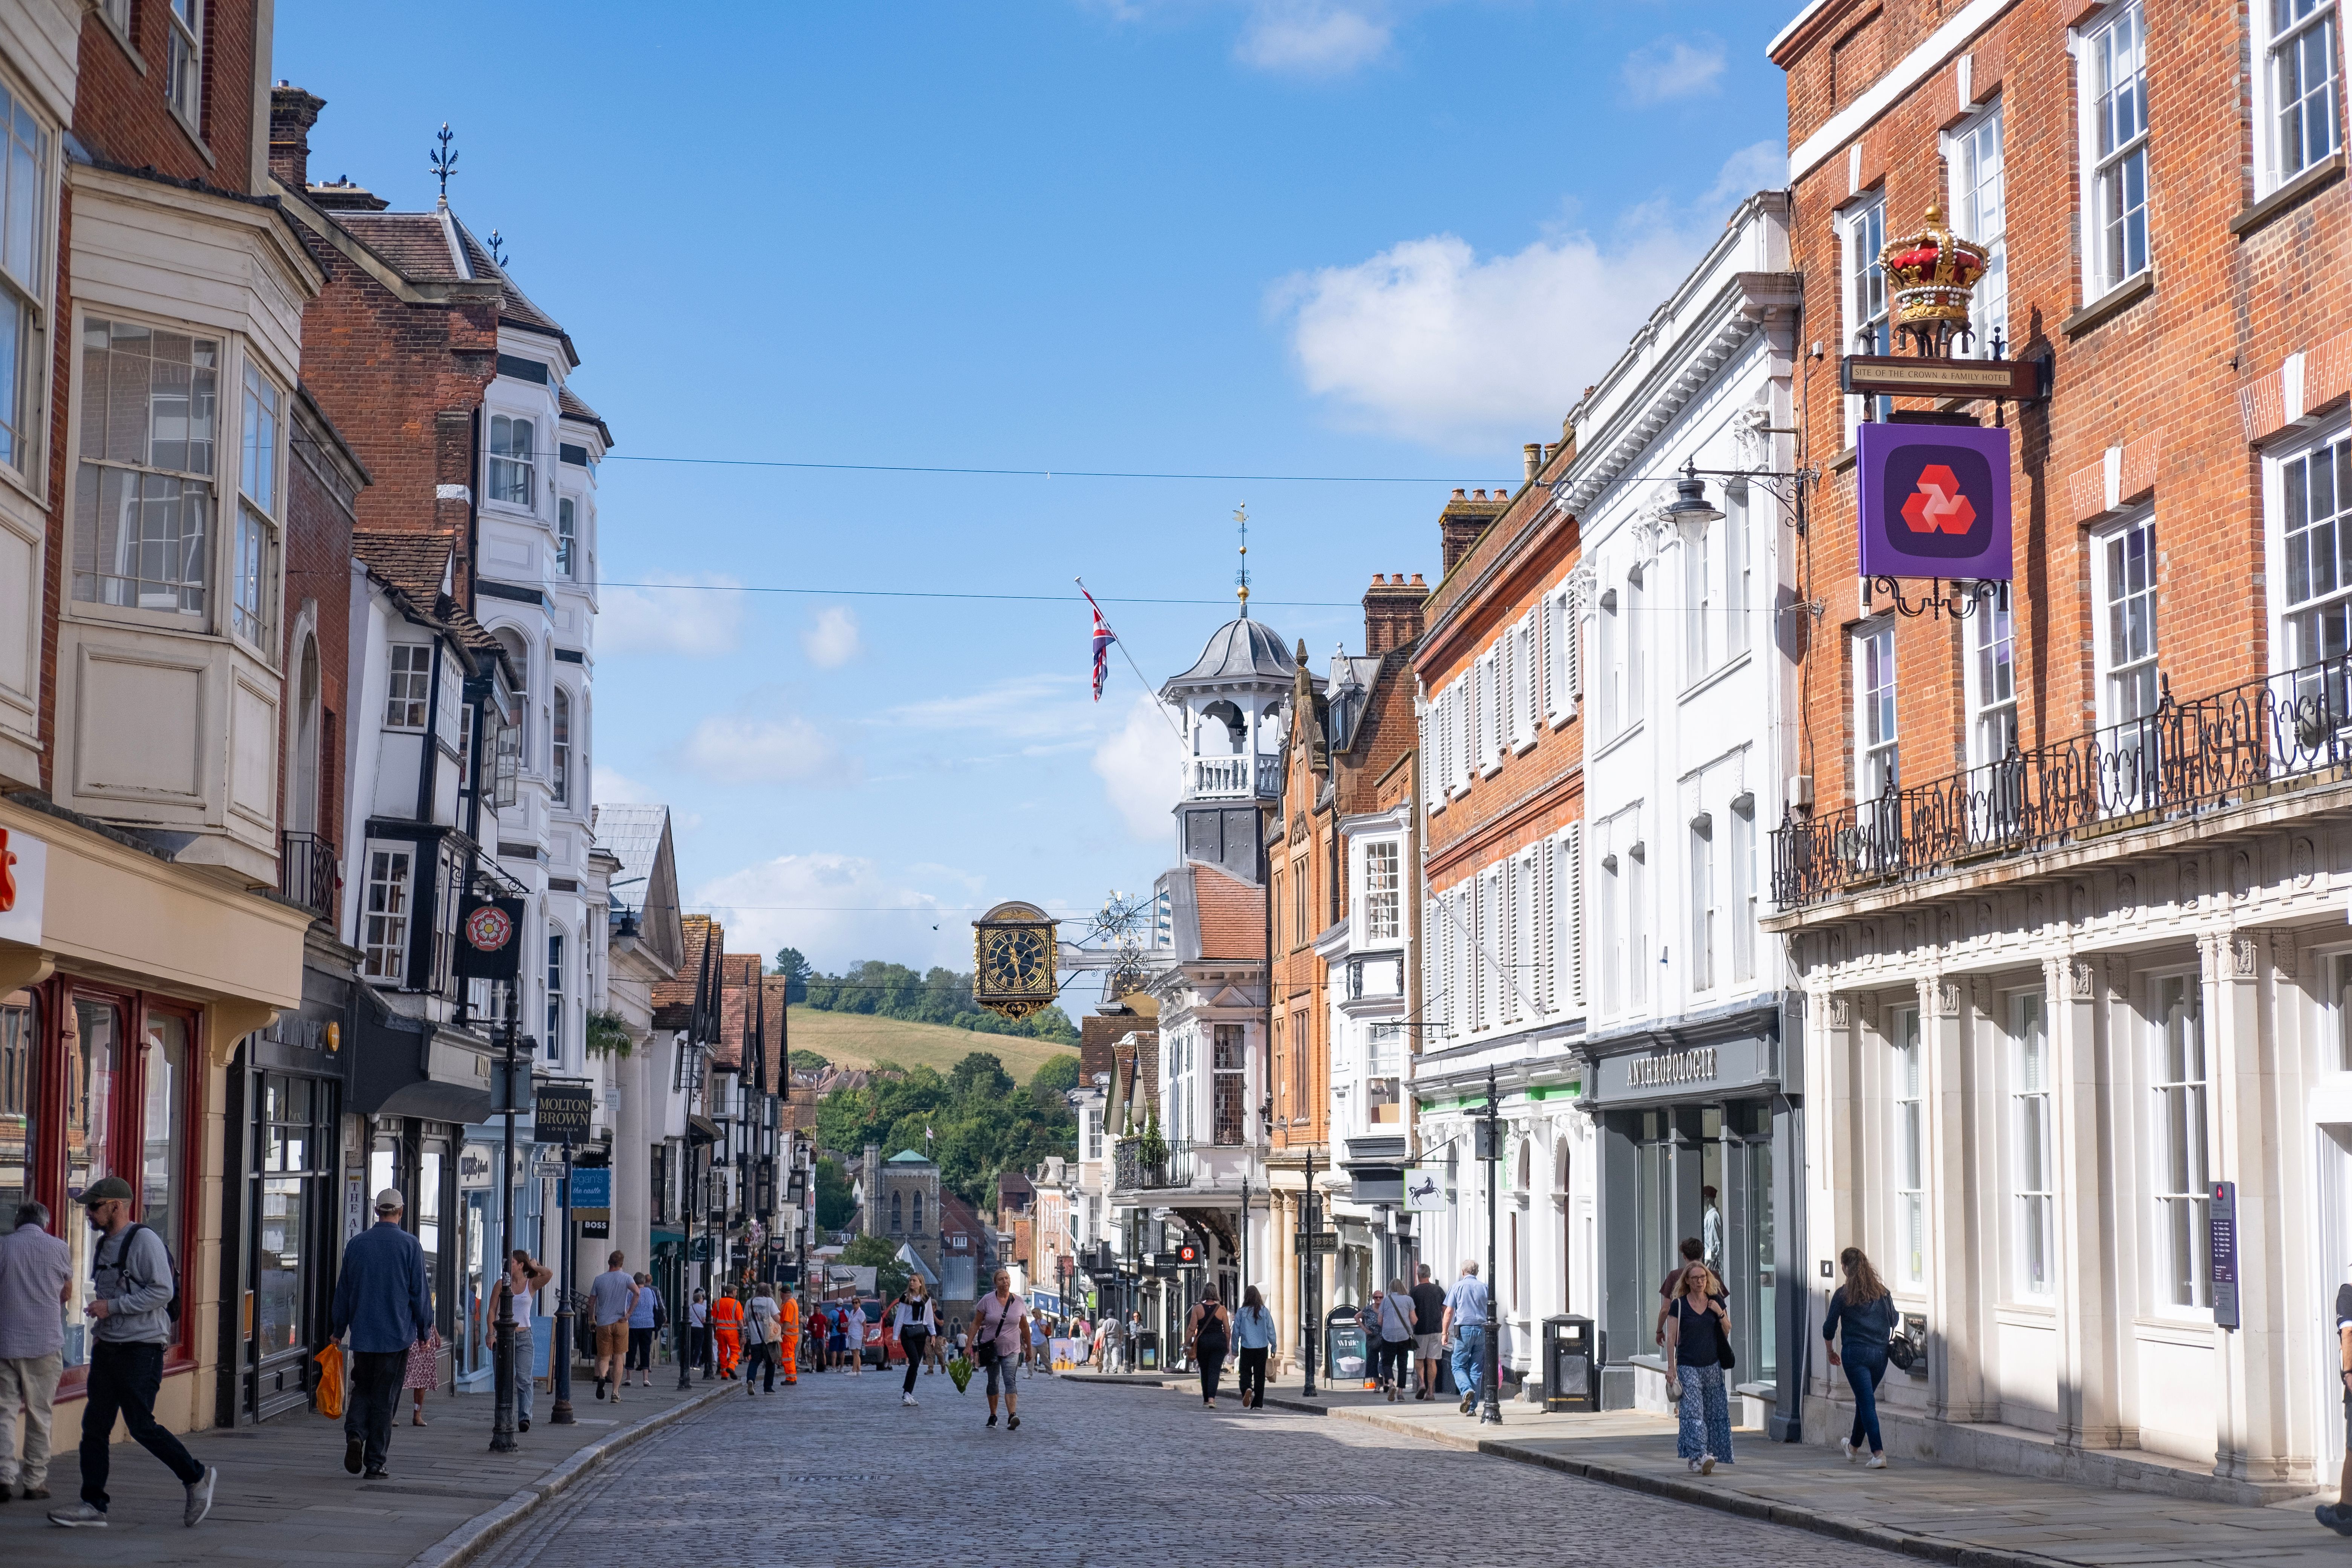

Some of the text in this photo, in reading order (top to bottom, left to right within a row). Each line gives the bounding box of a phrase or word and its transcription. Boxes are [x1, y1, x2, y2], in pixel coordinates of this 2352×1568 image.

[1951, 372, 1979, 381] FAMILY
[1627, 1047, 1713, 1086] ANTHROPOLOGIE
[539, 1098, 590, 1112] MOLTON
[538, 1112, 589, 1126] BROWN
[571, 1174, 603, 1185] egan's
[350, 1182, 359, 1213] THE
